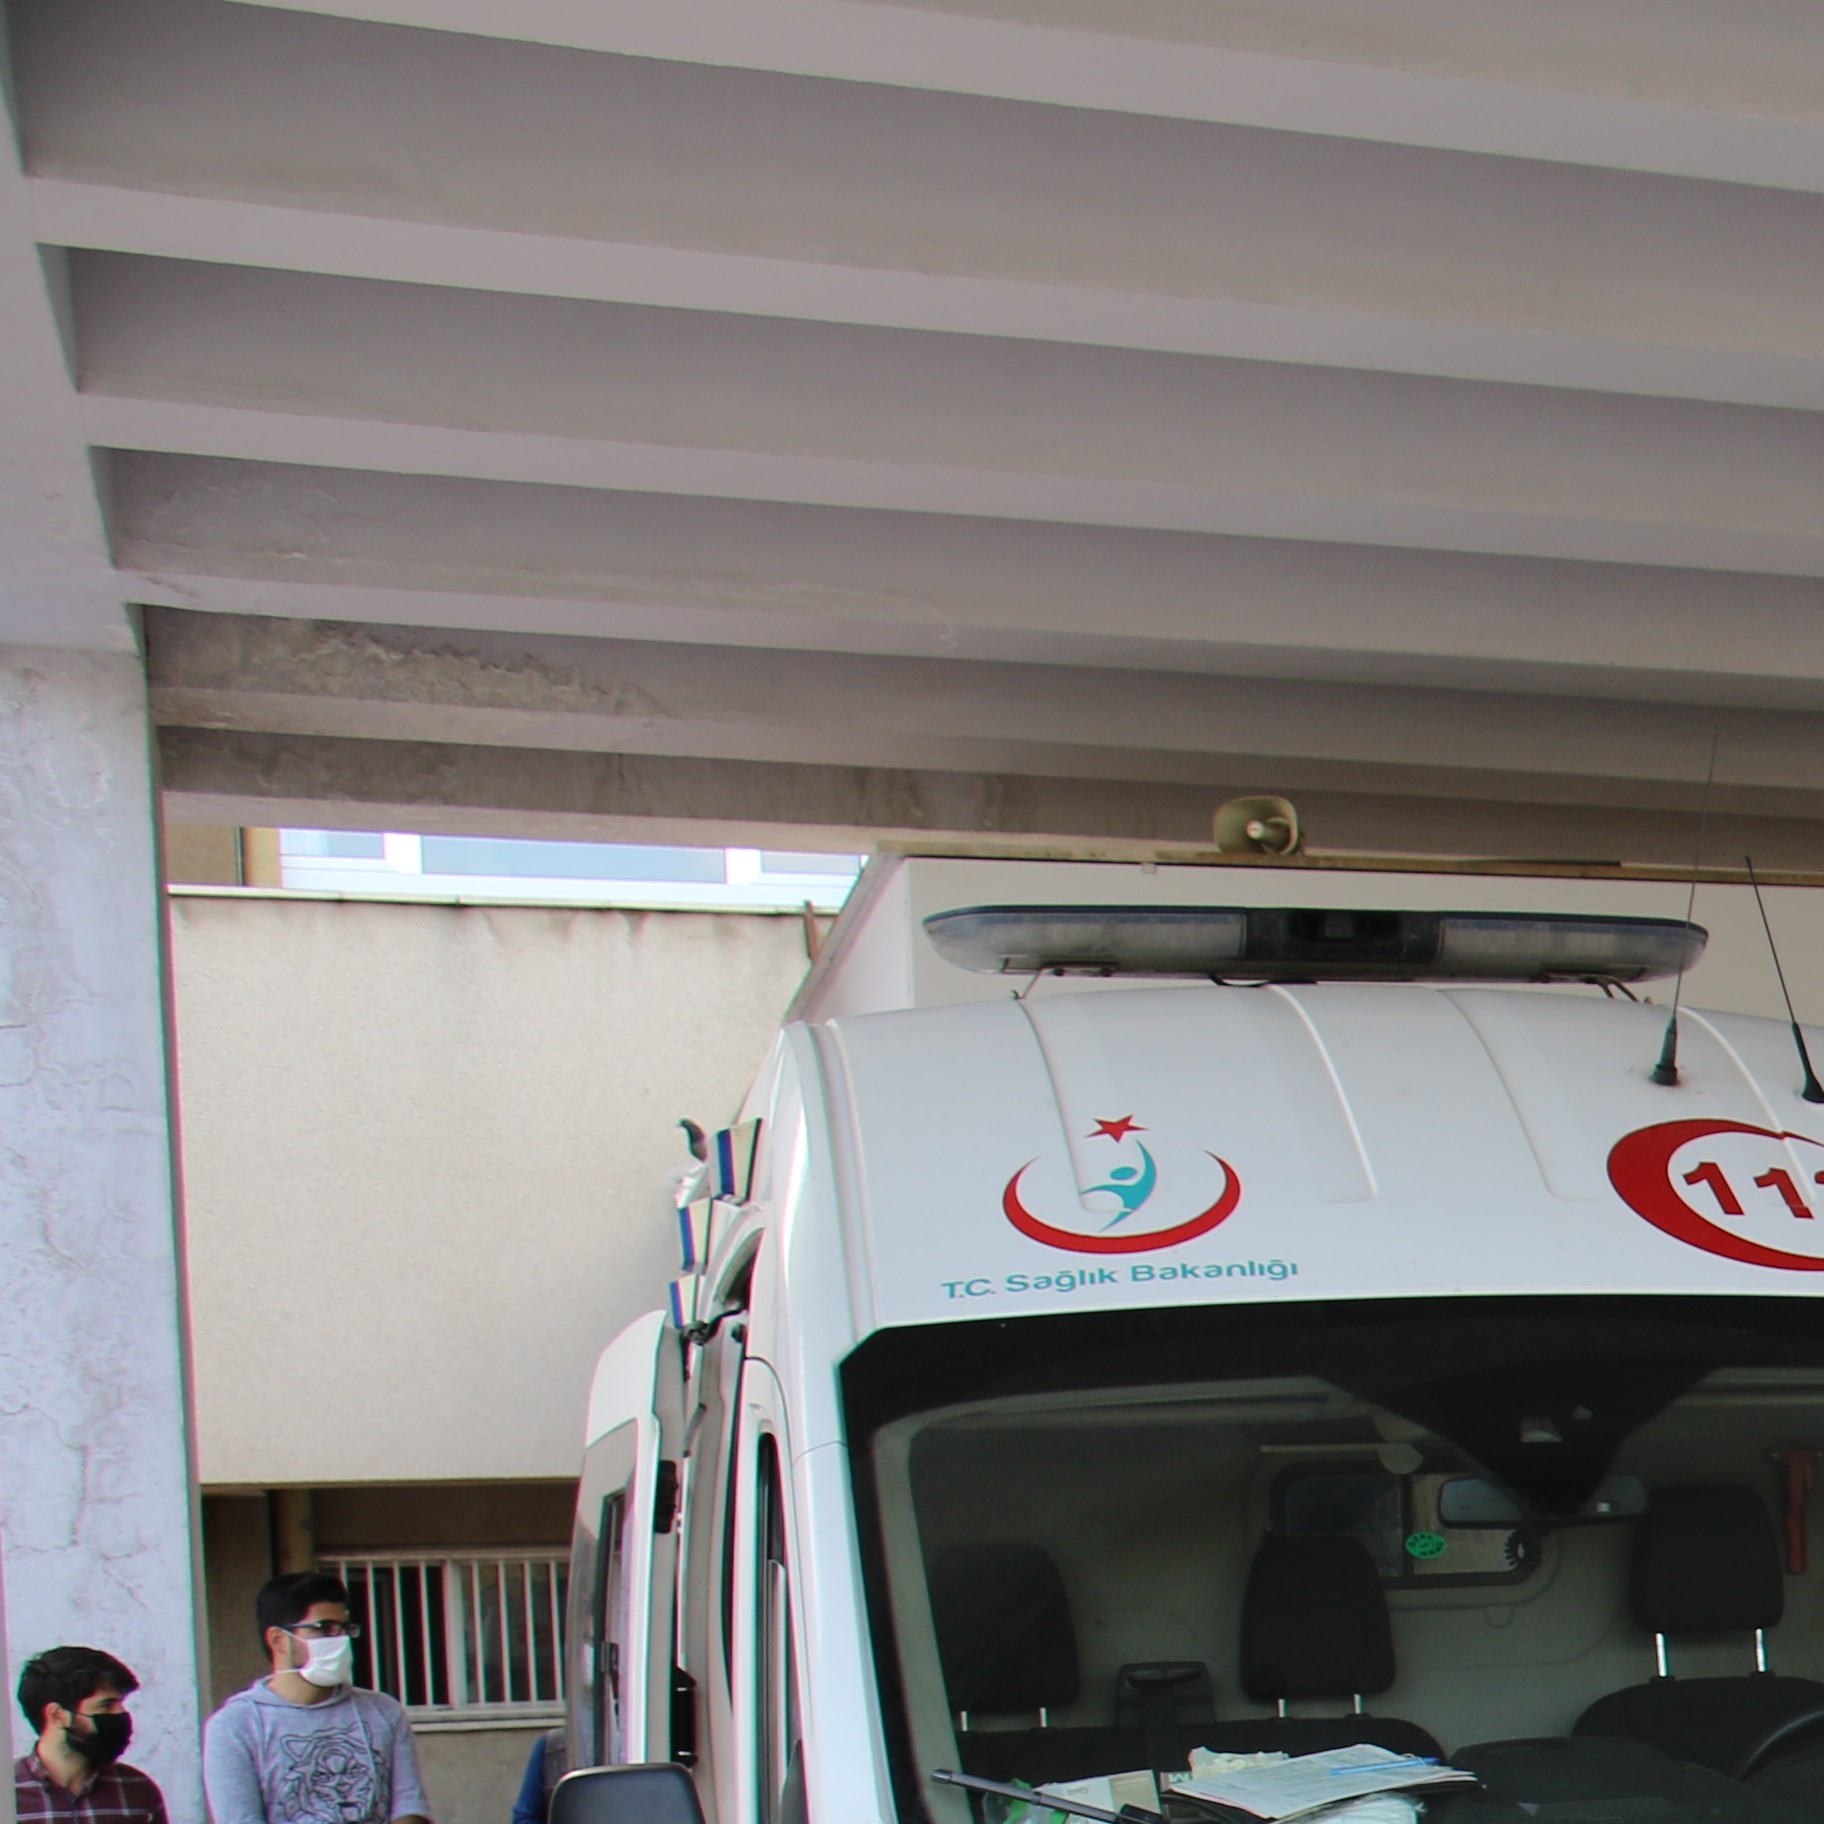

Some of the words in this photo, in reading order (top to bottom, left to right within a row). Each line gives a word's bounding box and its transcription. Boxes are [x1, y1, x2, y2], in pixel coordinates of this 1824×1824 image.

[940, 1278, 997, 1299] T.C.
[1004, 1268, 1119, 1293] Sağlık
[1129, 1259, 1299, 1282] Bakanlığı
